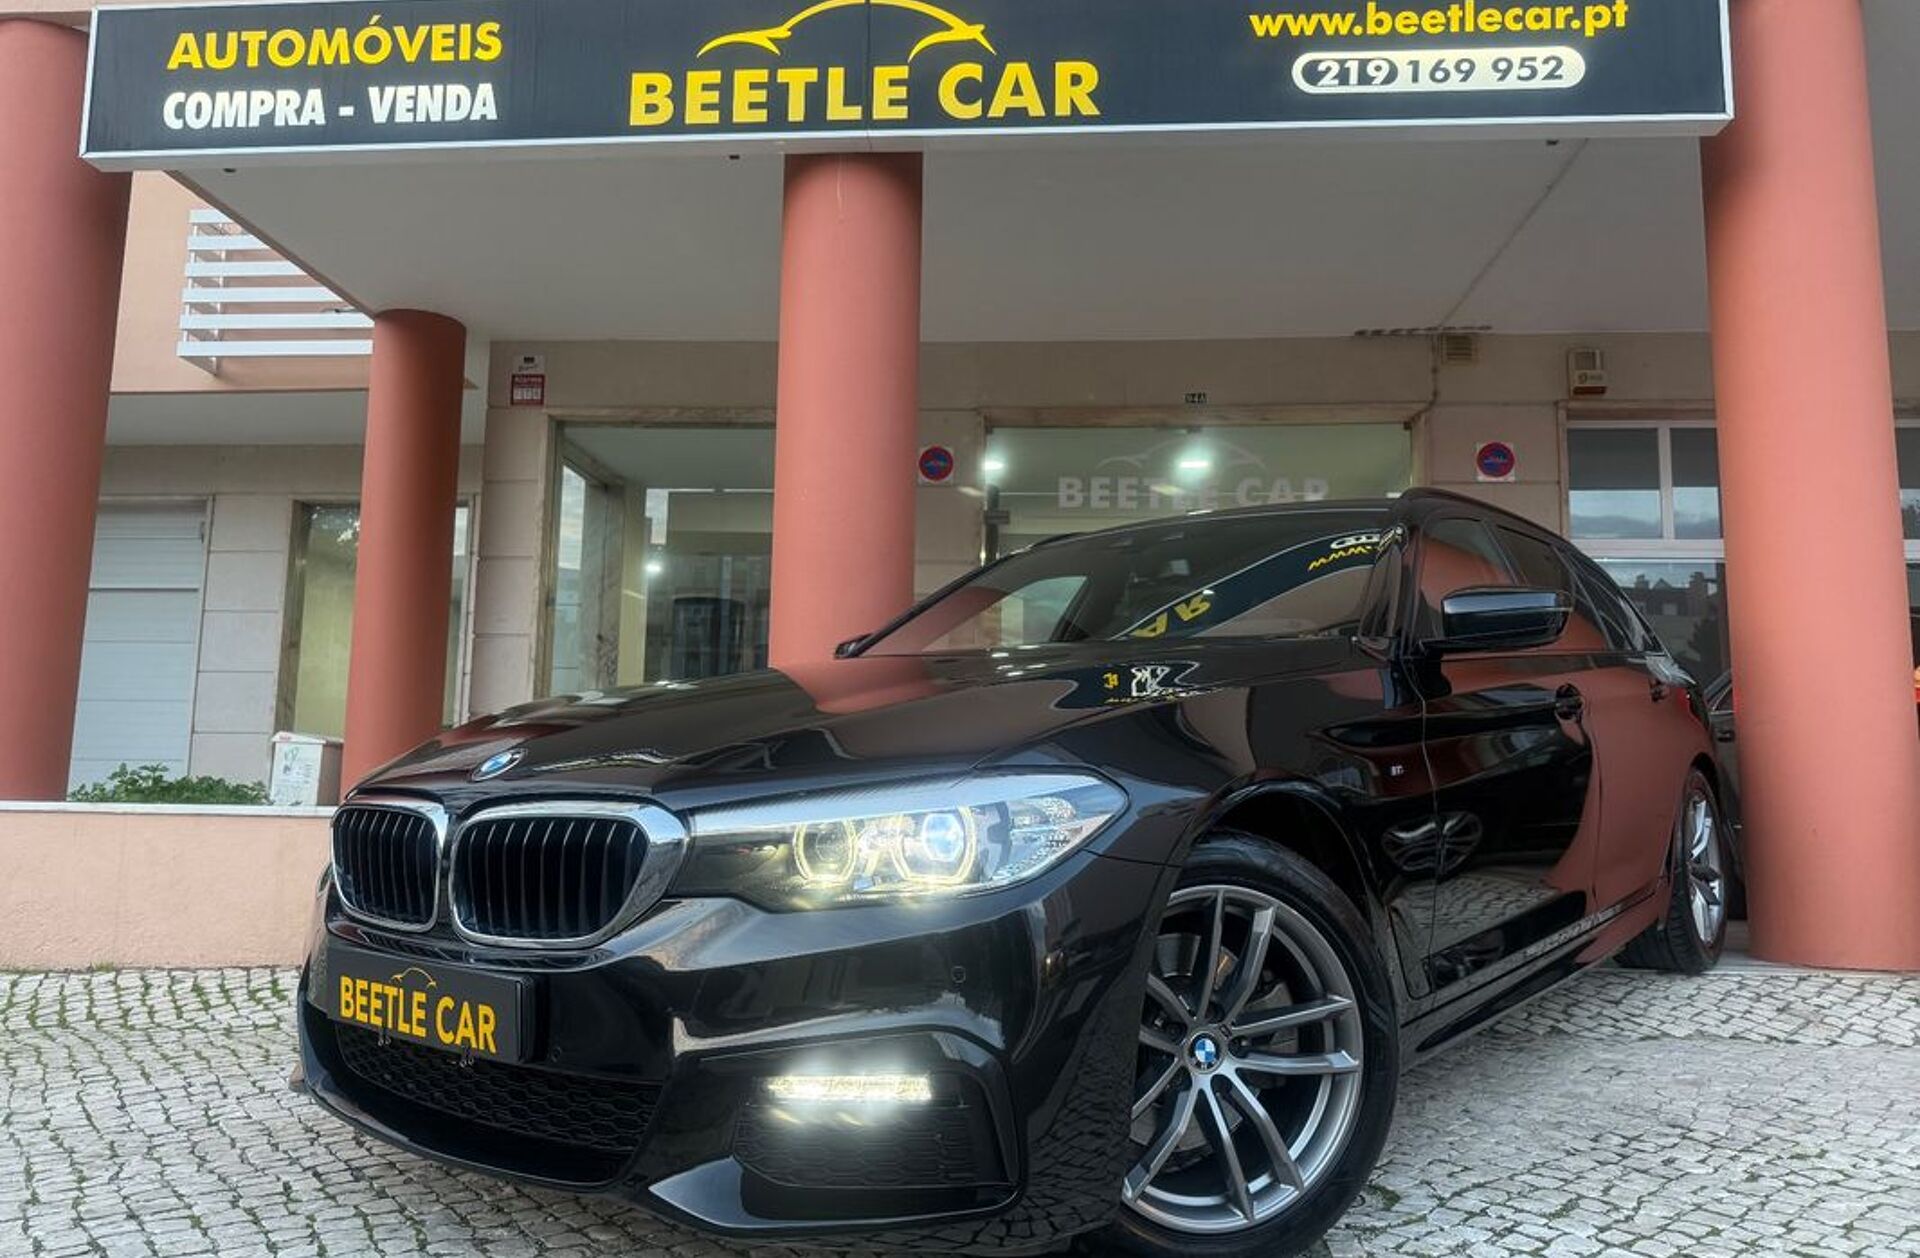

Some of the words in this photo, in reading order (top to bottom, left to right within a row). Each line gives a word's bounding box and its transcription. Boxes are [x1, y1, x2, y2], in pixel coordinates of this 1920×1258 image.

[167, 15, 503, 71] AUTOMÓVEIS
[1249, 0, 1629, 37] www.beetlecar.pt
[629, 65, 910, 127] BEETLE
[937, 60, 1100, 119] CAR
[1316, 59, 1392, 87] 219
[1407, 58, 1477, 84] 169
[1491, 55, 1565, 83] 952
[162, 88, 326, 130] COMPRA
[367, 82, 498, 125] VENDA
[340, 974, 427, 1038] BEETLE
[435, 995, 497, 1054] CAR
